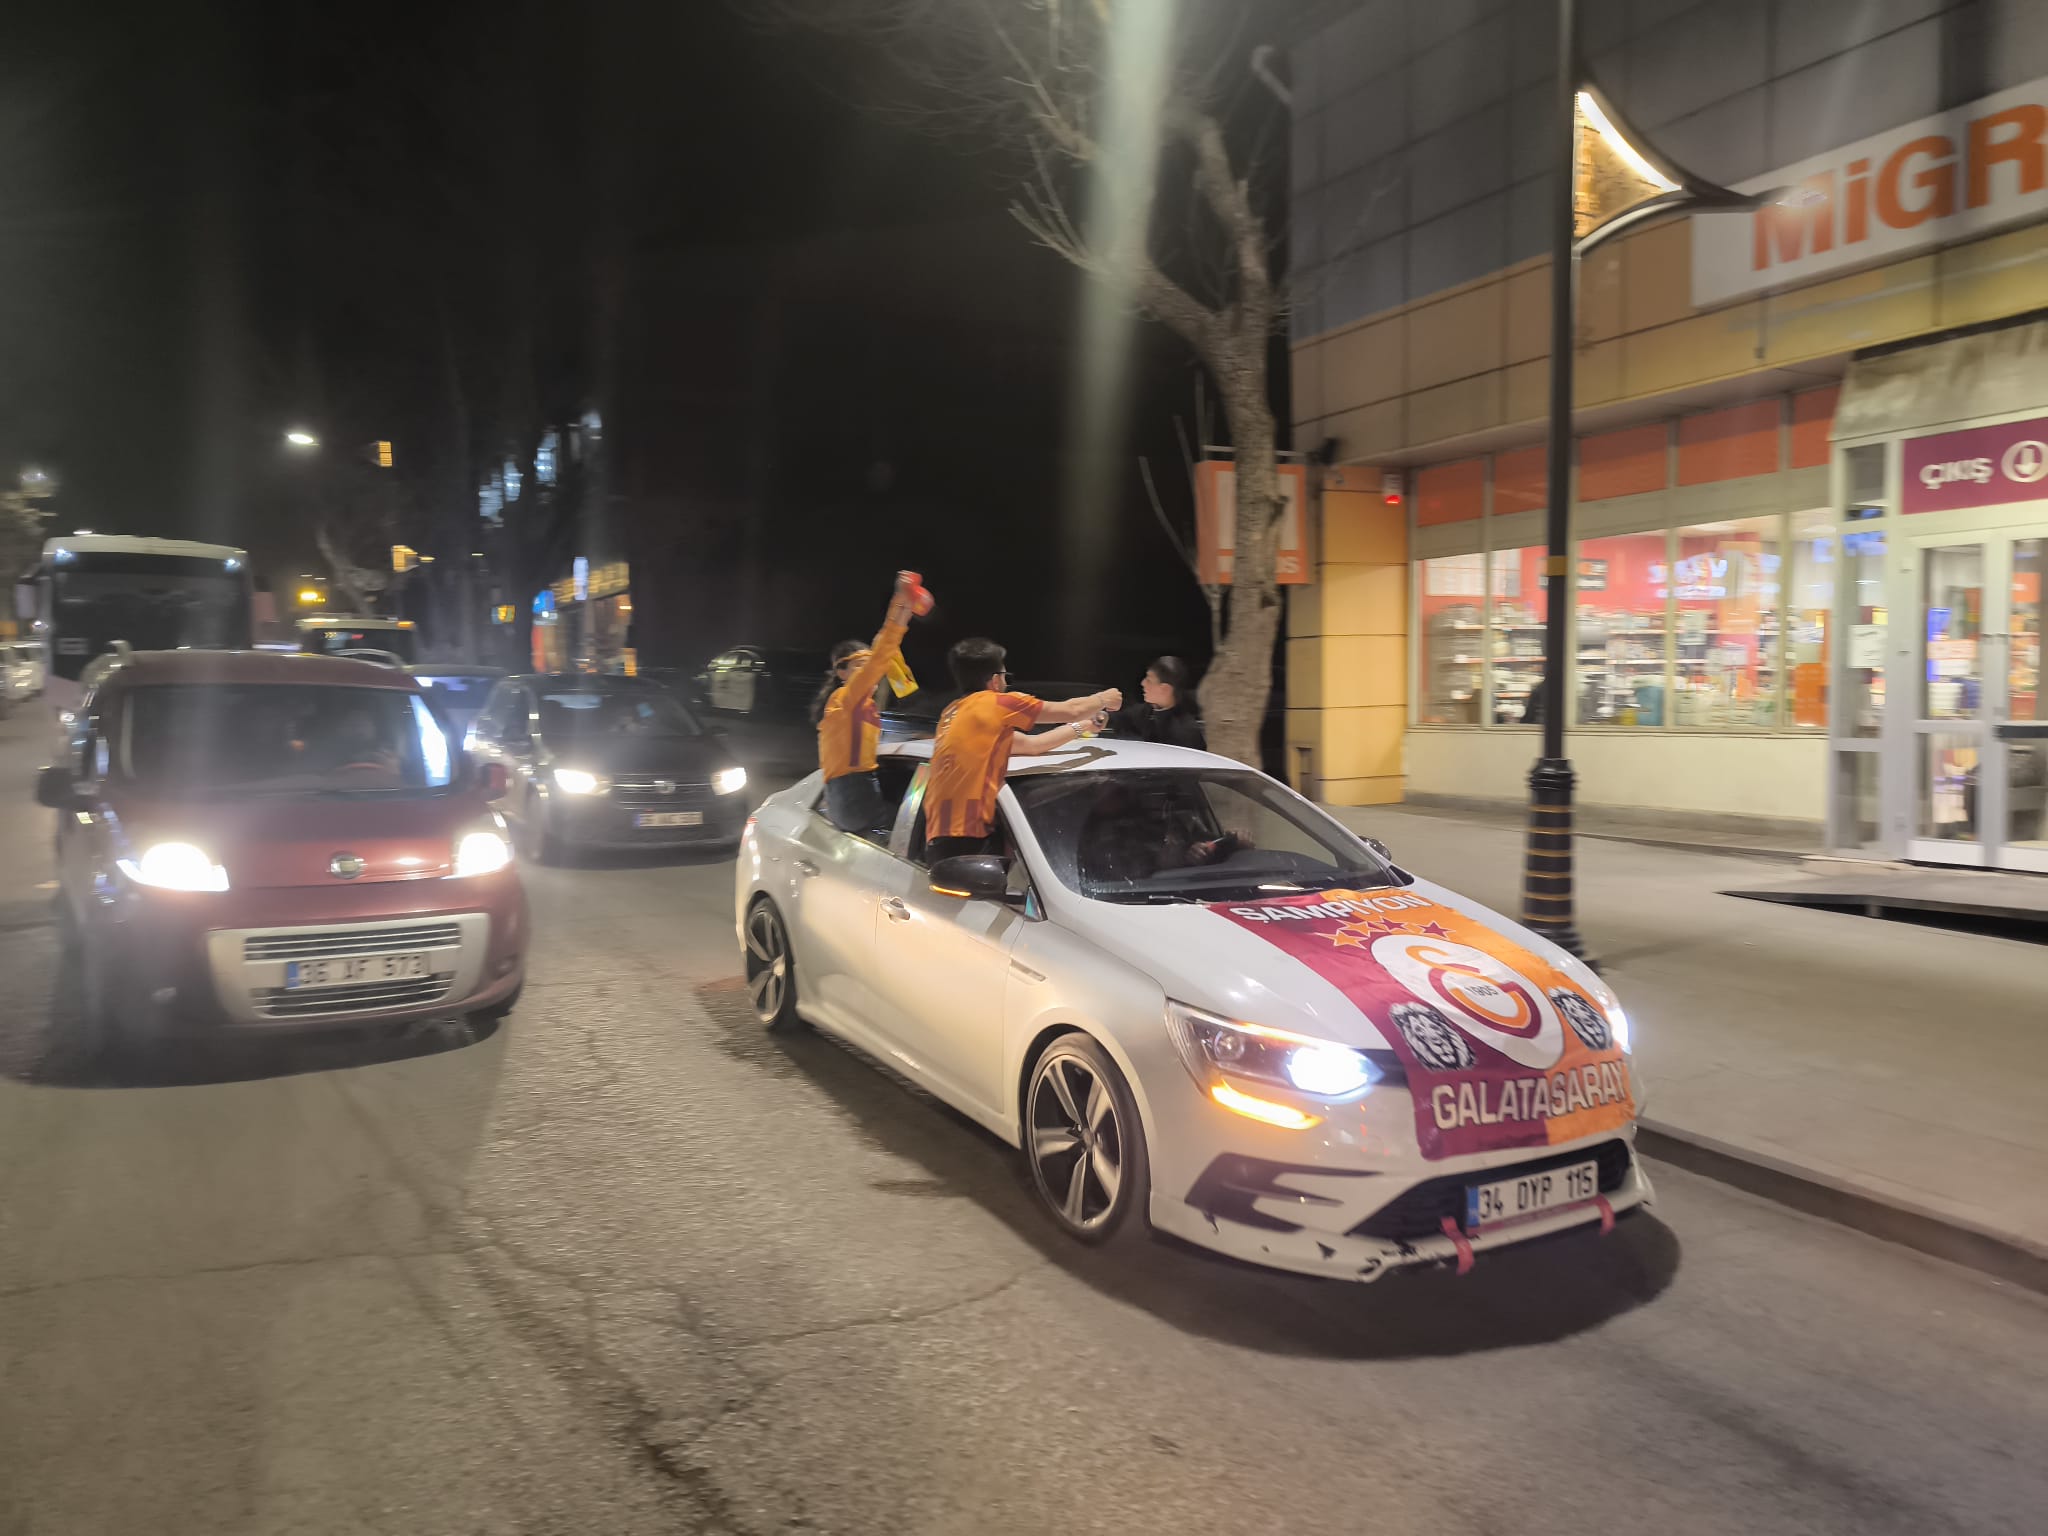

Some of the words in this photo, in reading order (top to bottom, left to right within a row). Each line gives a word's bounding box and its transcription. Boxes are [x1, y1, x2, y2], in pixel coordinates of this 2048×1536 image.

[1919, 457, 1993, 490] ÇIKIŞ
[1432, 1060, 1626, 1130] GALATASARAY
[1480, 1187, 1504, 1219] 34
[1566, 1165, 1593, 1199] 115
